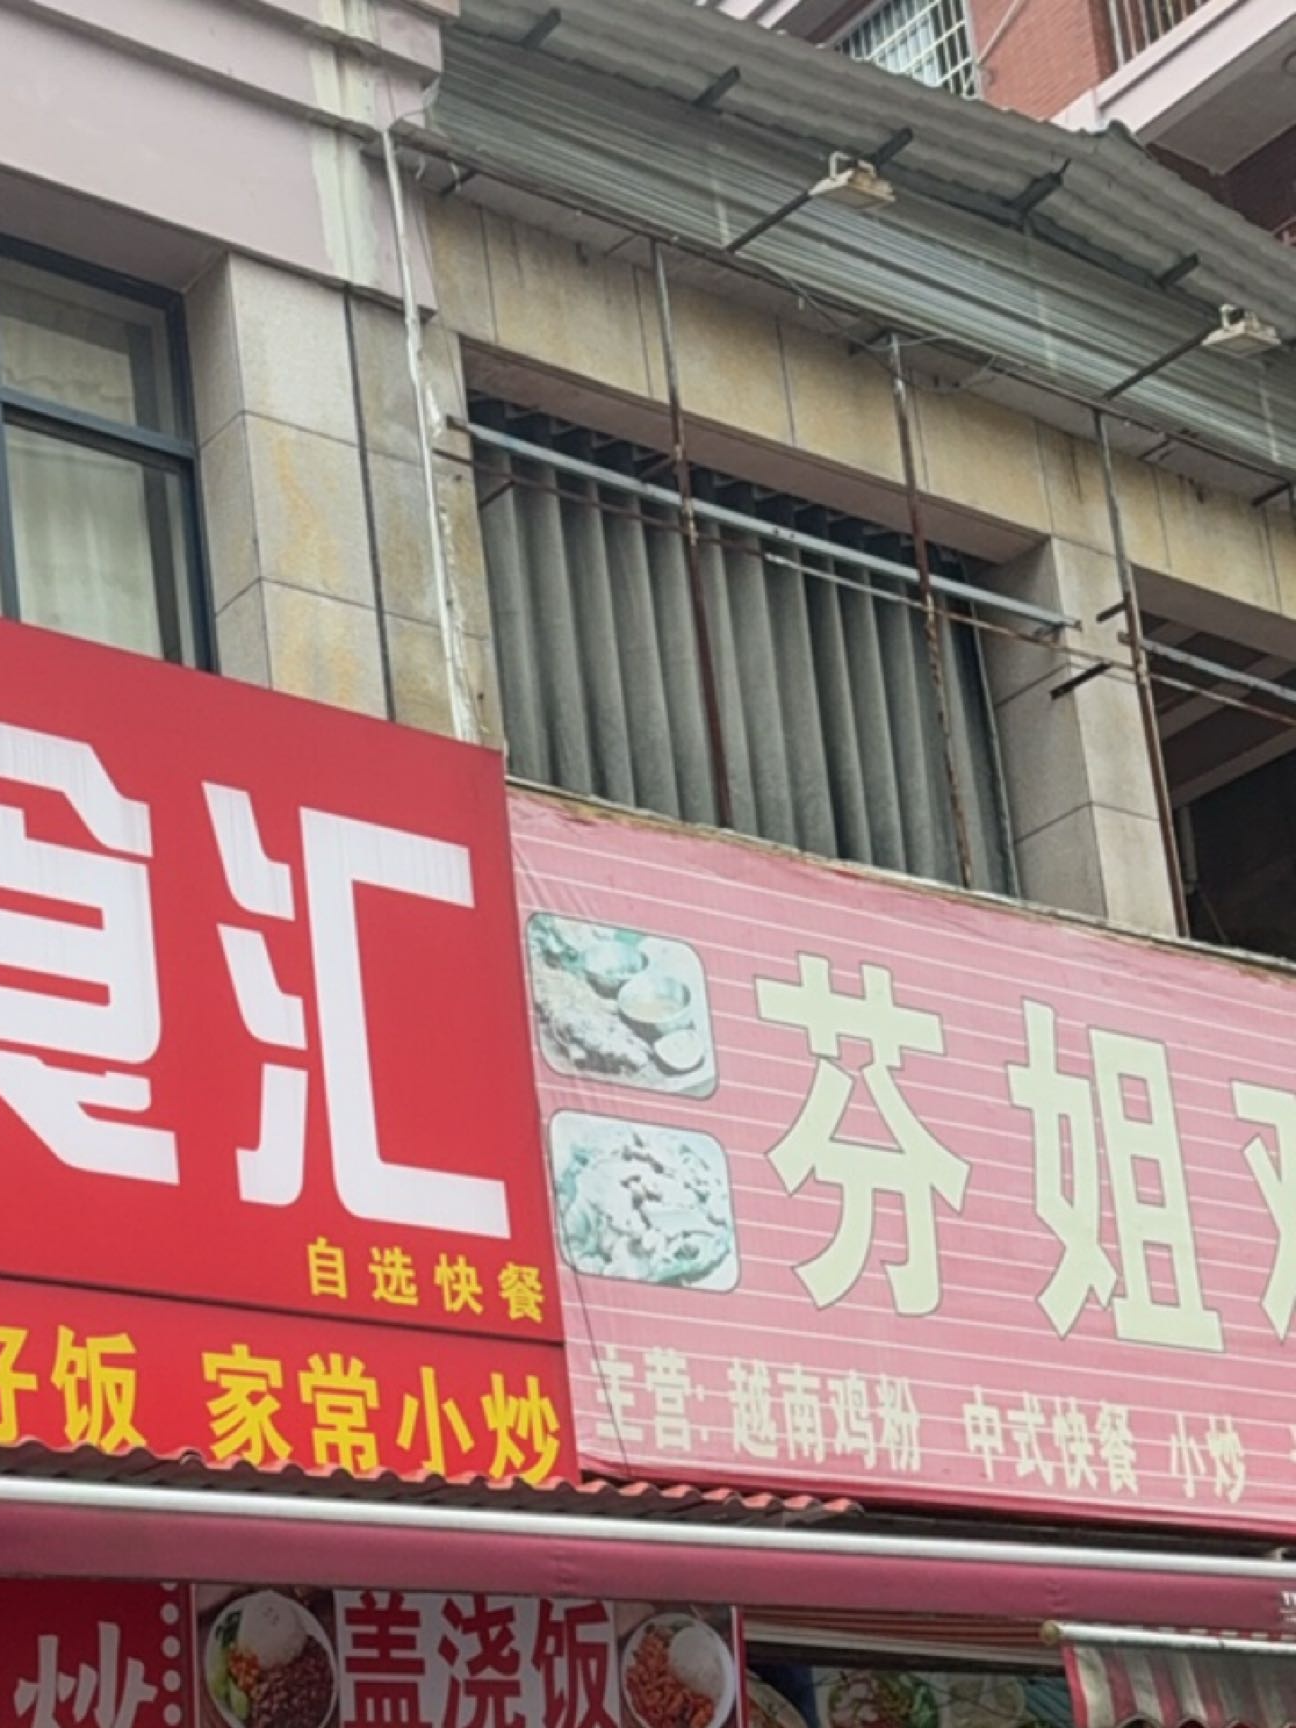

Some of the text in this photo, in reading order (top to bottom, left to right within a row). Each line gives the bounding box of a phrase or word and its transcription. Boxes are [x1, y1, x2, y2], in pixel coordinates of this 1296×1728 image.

[307, 1238, 545, 1324] 自选快餐
[202, 1343, 561, 1485] 家常小炒
[727, 1357, 921, 1472] 越南鸡粉
[963, 1384, 1138, 1495] 中式快餐
[1170, 1411, 1246, 1504] 小炒
